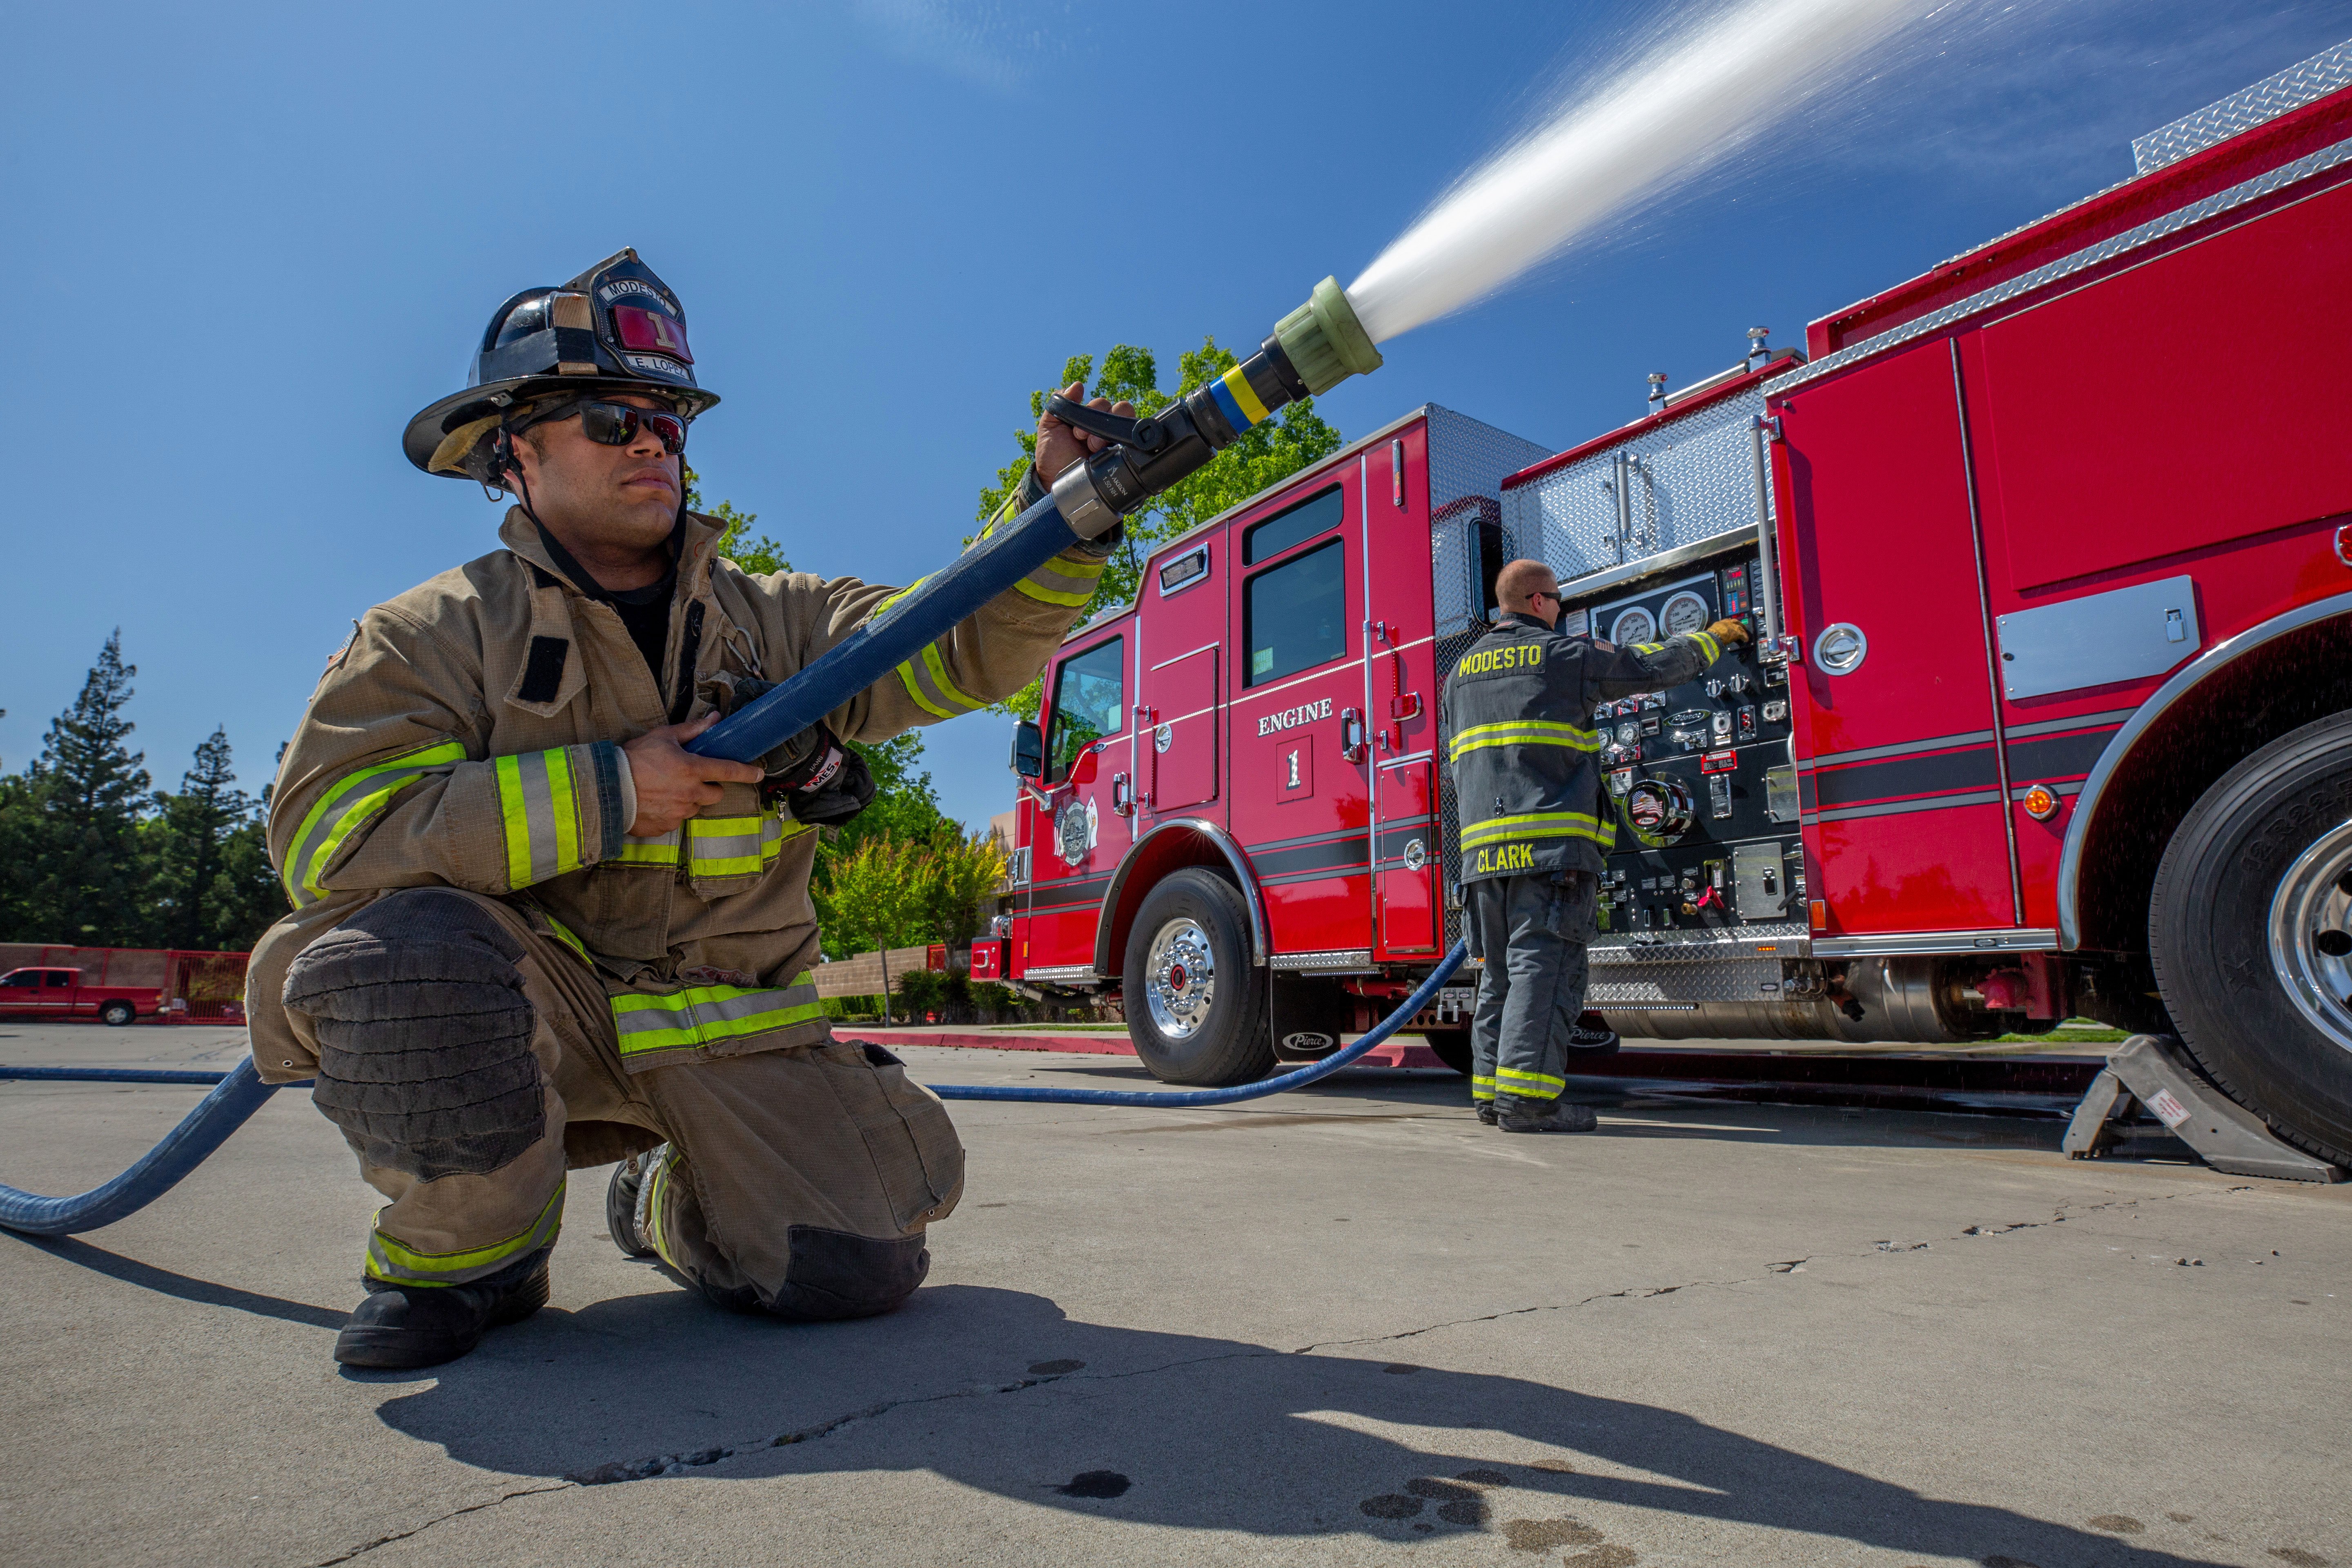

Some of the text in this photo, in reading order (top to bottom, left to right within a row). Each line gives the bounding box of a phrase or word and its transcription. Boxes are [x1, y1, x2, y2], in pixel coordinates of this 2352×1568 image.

[608, 281, 666, 307] MODESTO
[646, 312, 677, 350] 1
[635, 357, 686, 378] E. LOPEZ
[1103, 476, 1118, 497] 1.50 NH
[1112, 477, 1128, 496] AKRON
[1458, 645, 1541, 678] MODESTO
[1258, 697, 1332, 738] ENGINE
[812, 763, 835, 786] MES
[1287, 749, 1301, 790] 1
[1478, 843, 1535, 873] CLARK
[1294, 1034, 1323, 1047] Pierce
[1570, 1028, 1606, 1042] Pierce
